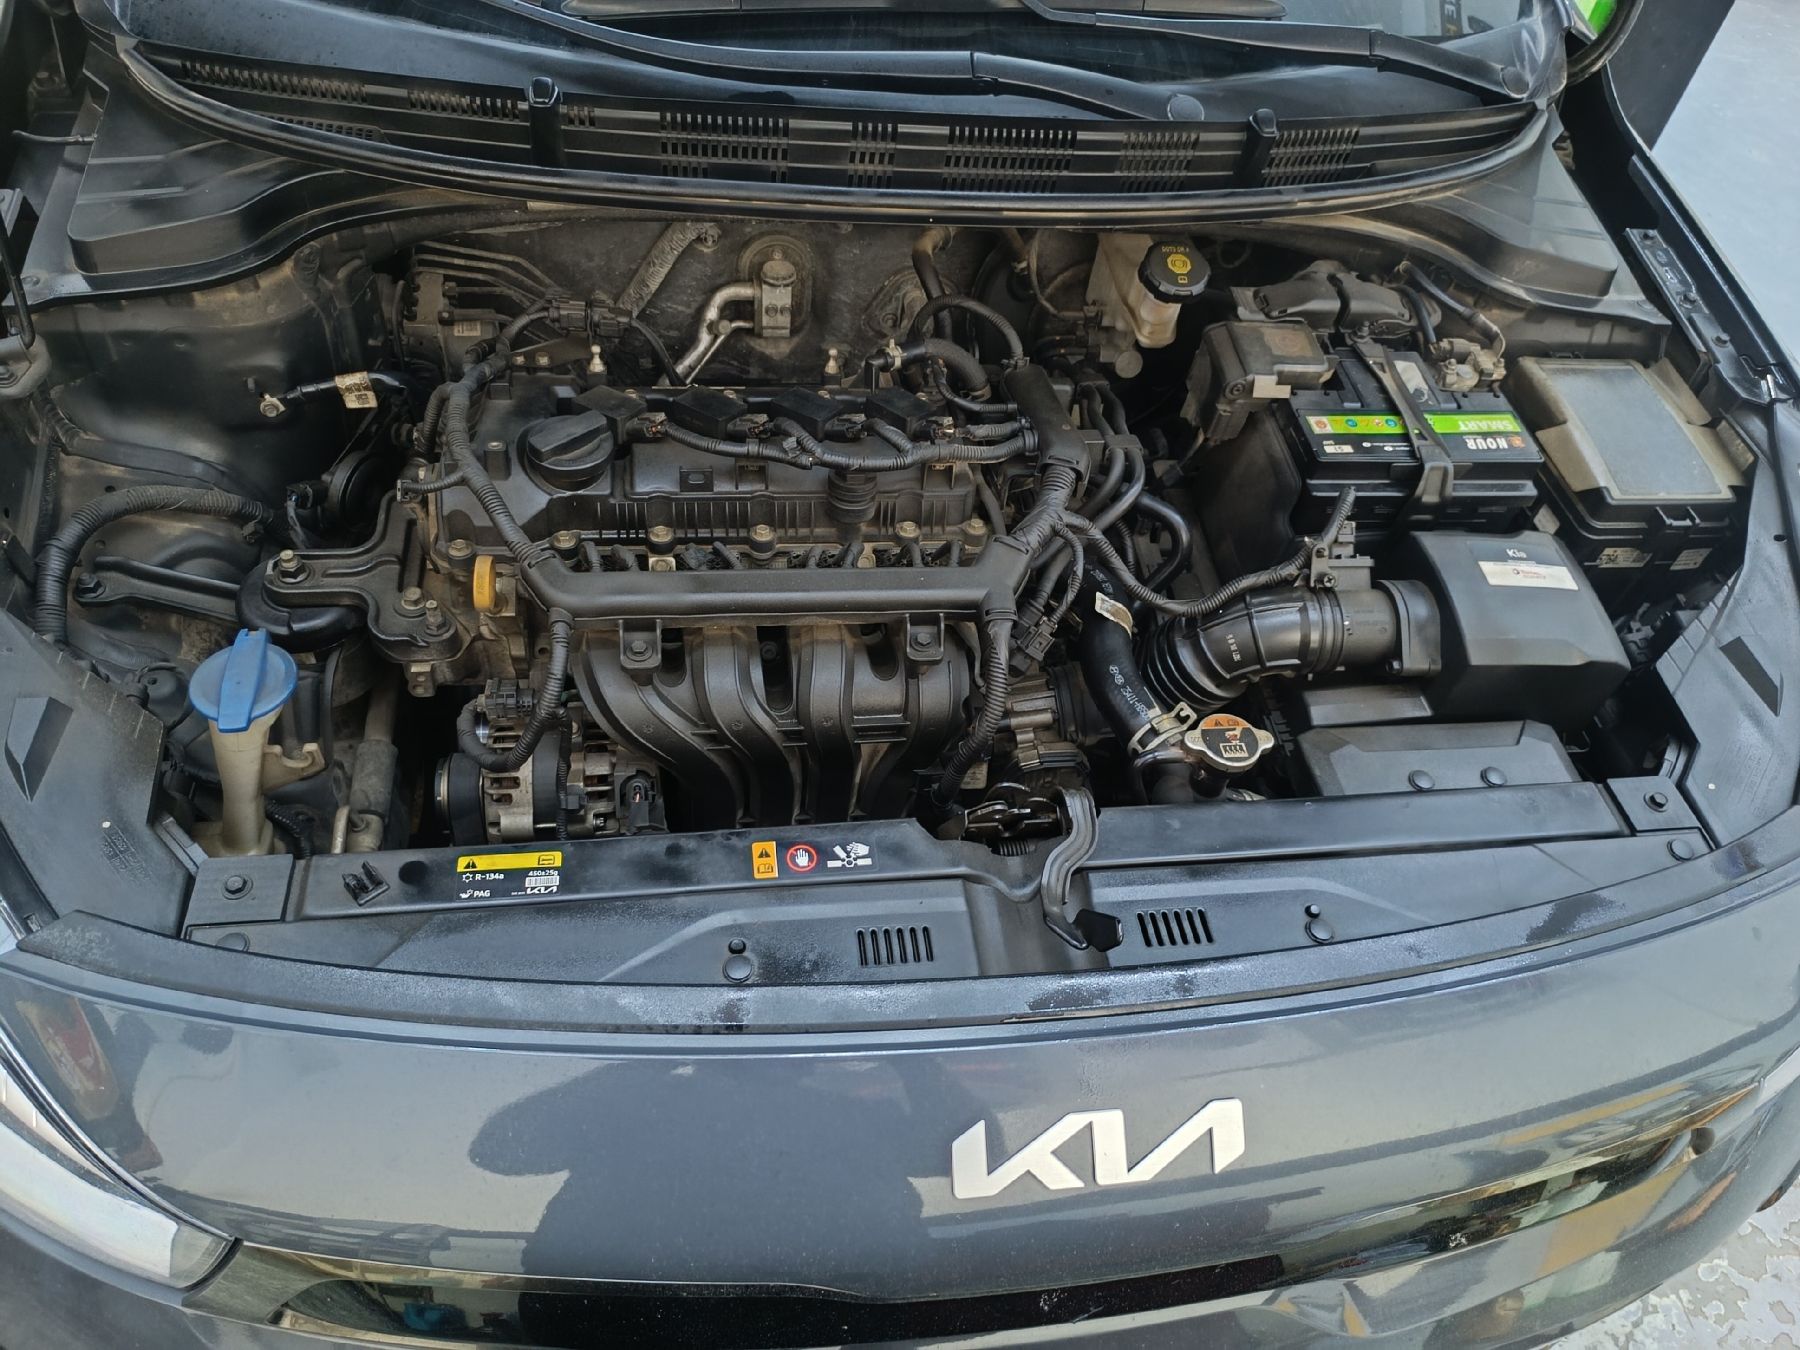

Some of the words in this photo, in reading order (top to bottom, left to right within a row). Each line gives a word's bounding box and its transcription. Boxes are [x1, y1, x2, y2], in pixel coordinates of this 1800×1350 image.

[1458, 420, 1513, 431] SMART
[1465, 437, 1508, 450] NOUR
[473, 890, 491, 898] PAG
[951, 1097, 1245, 1199] KIA
